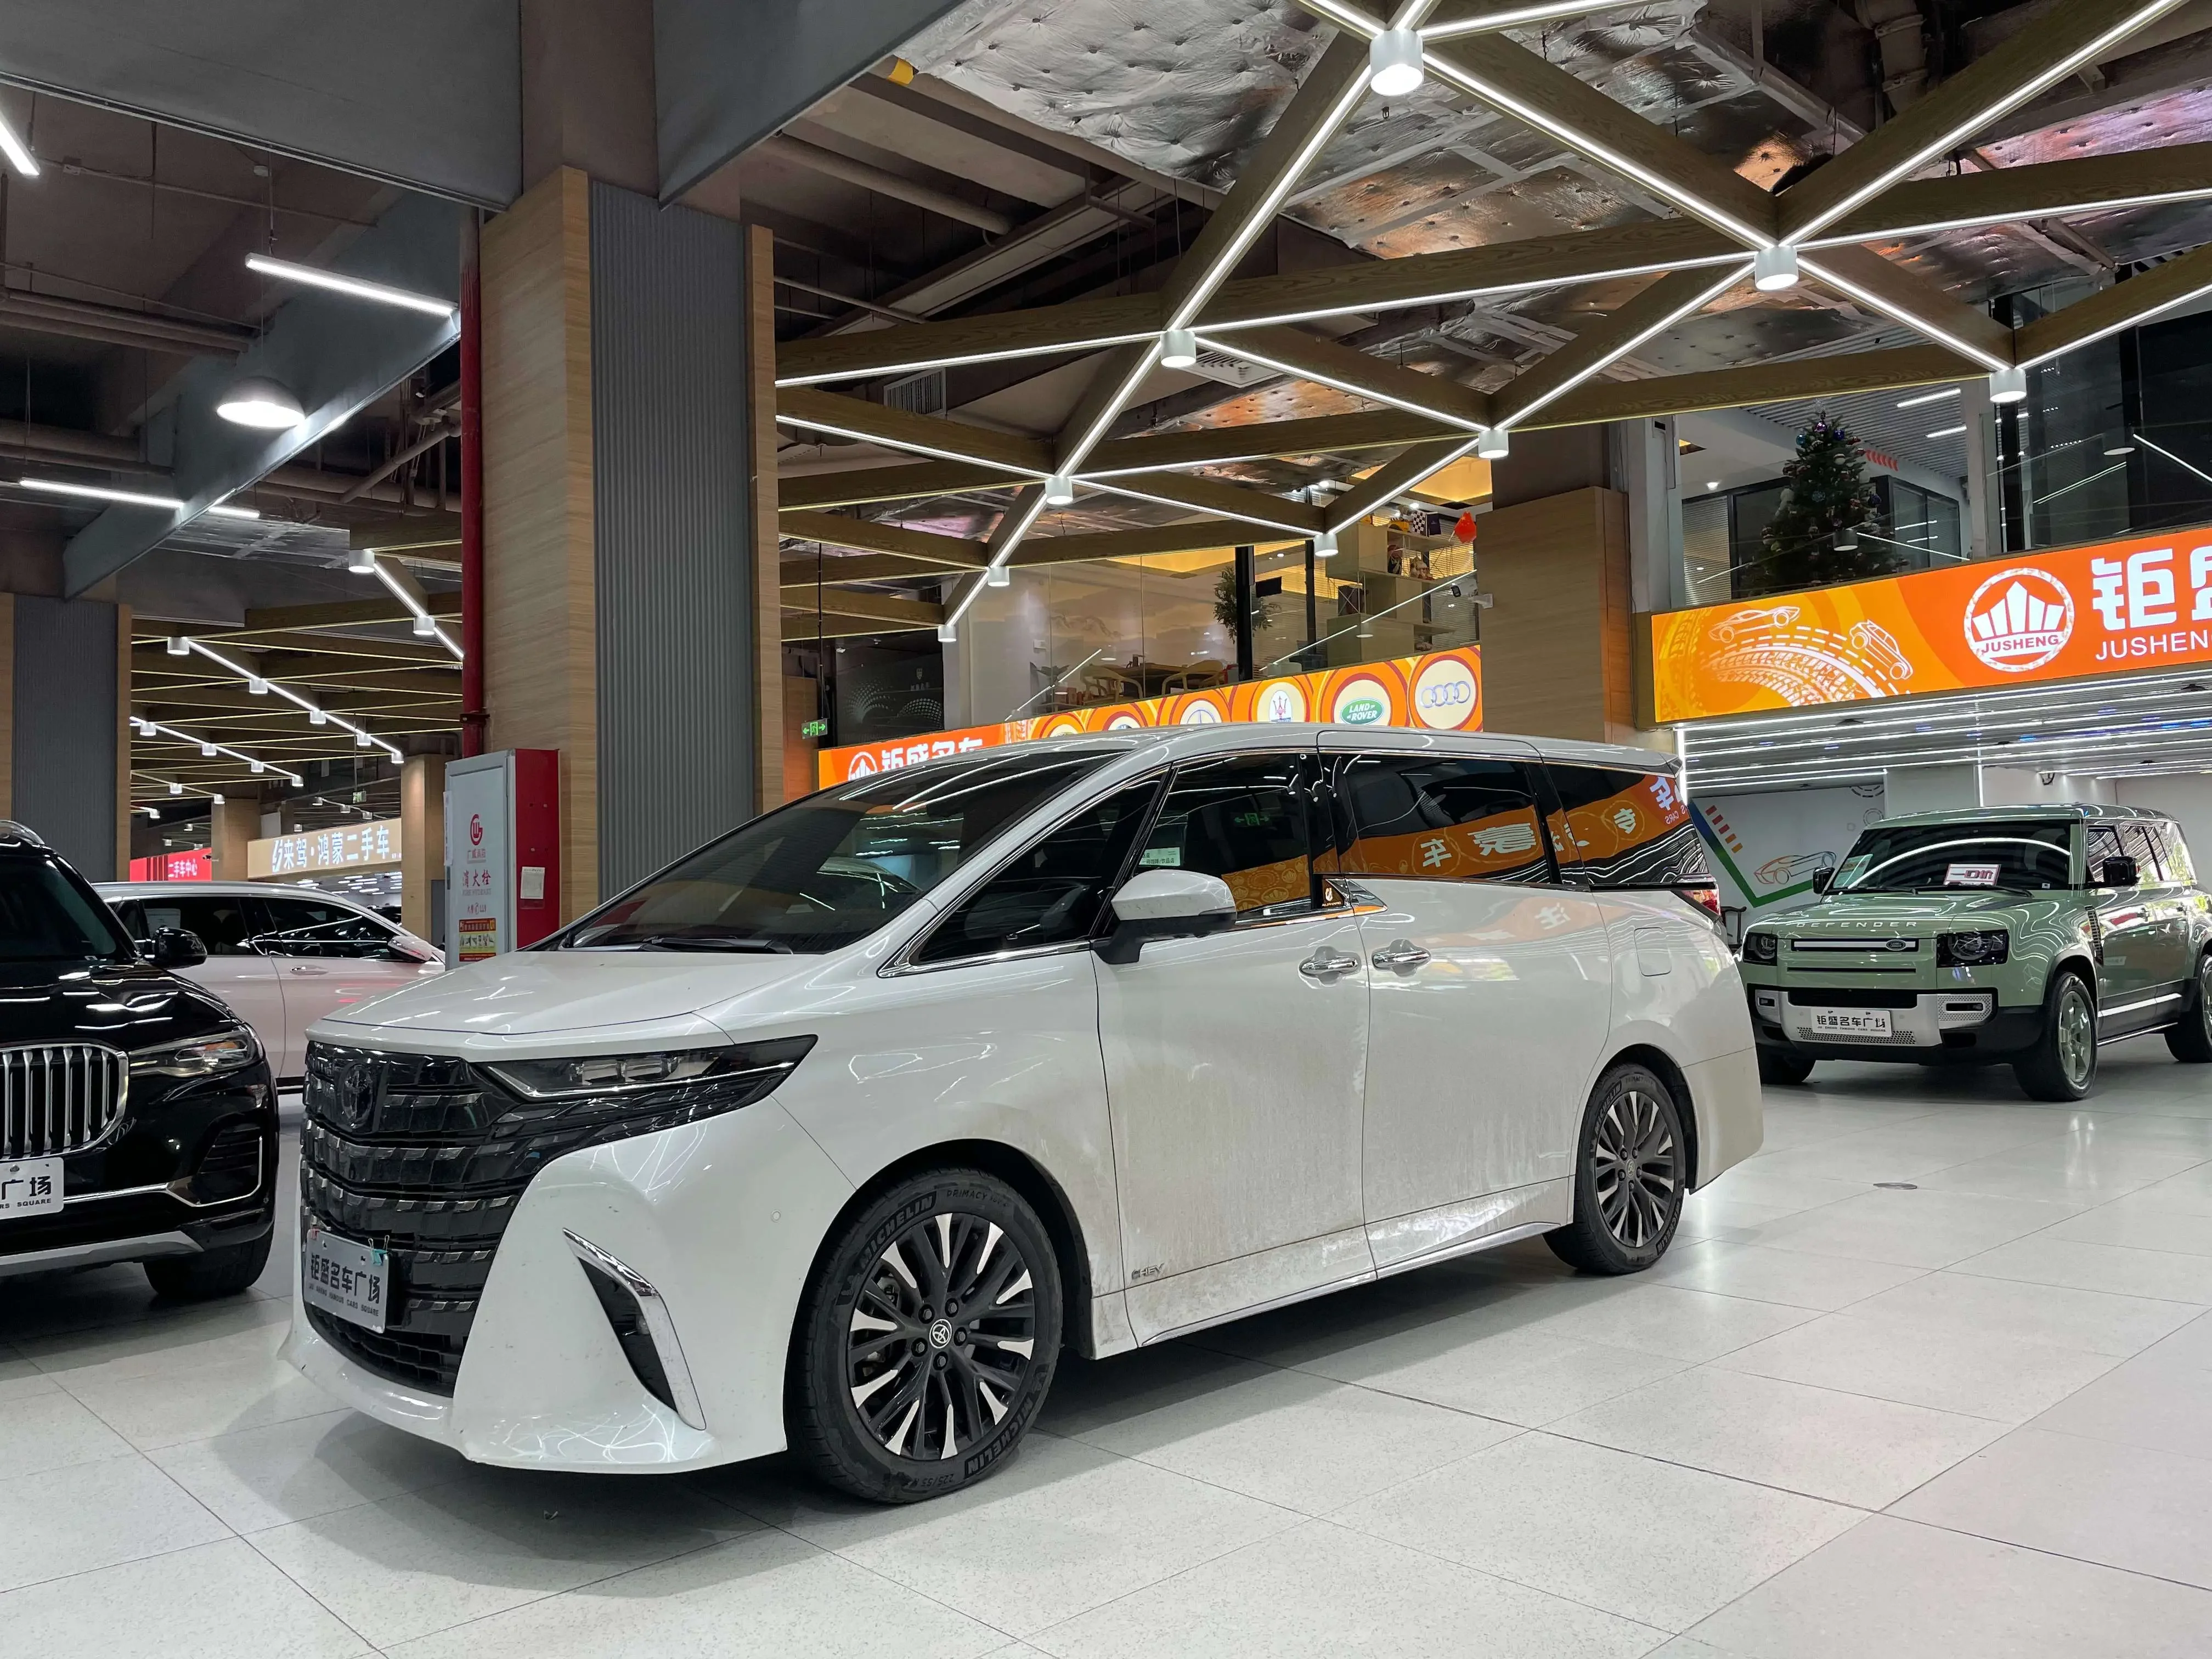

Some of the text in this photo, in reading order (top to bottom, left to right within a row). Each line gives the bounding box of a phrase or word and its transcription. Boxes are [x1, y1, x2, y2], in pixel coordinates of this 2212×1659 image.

[2091, 545, 2212, 631] 钜
[1981, 634, 2060, 654] JUSHENG
[2095, 629, 2212, 661] JUSHEN
[1349, 703, 1370, 713] LAND
[1351, 710, 1378, 721] ROVER
[168, 859, 198, 878] 二手车中心
[1595, 1081, 1621, 1135] MICHELIN
[2, 1176, 52, 1200] 广场
[947, 1189, 987, 1201] PRIMACY
[17, 1198, 52, 1207] SQUARE
[859, 1195, 934, 1269] MICHELIN
[311, 1253, 380, 1304] 钜盛名车广场
[361, 1304, 379, 1317] SQUARE
[967, 1398, 1035, 1475] MICHELIN
